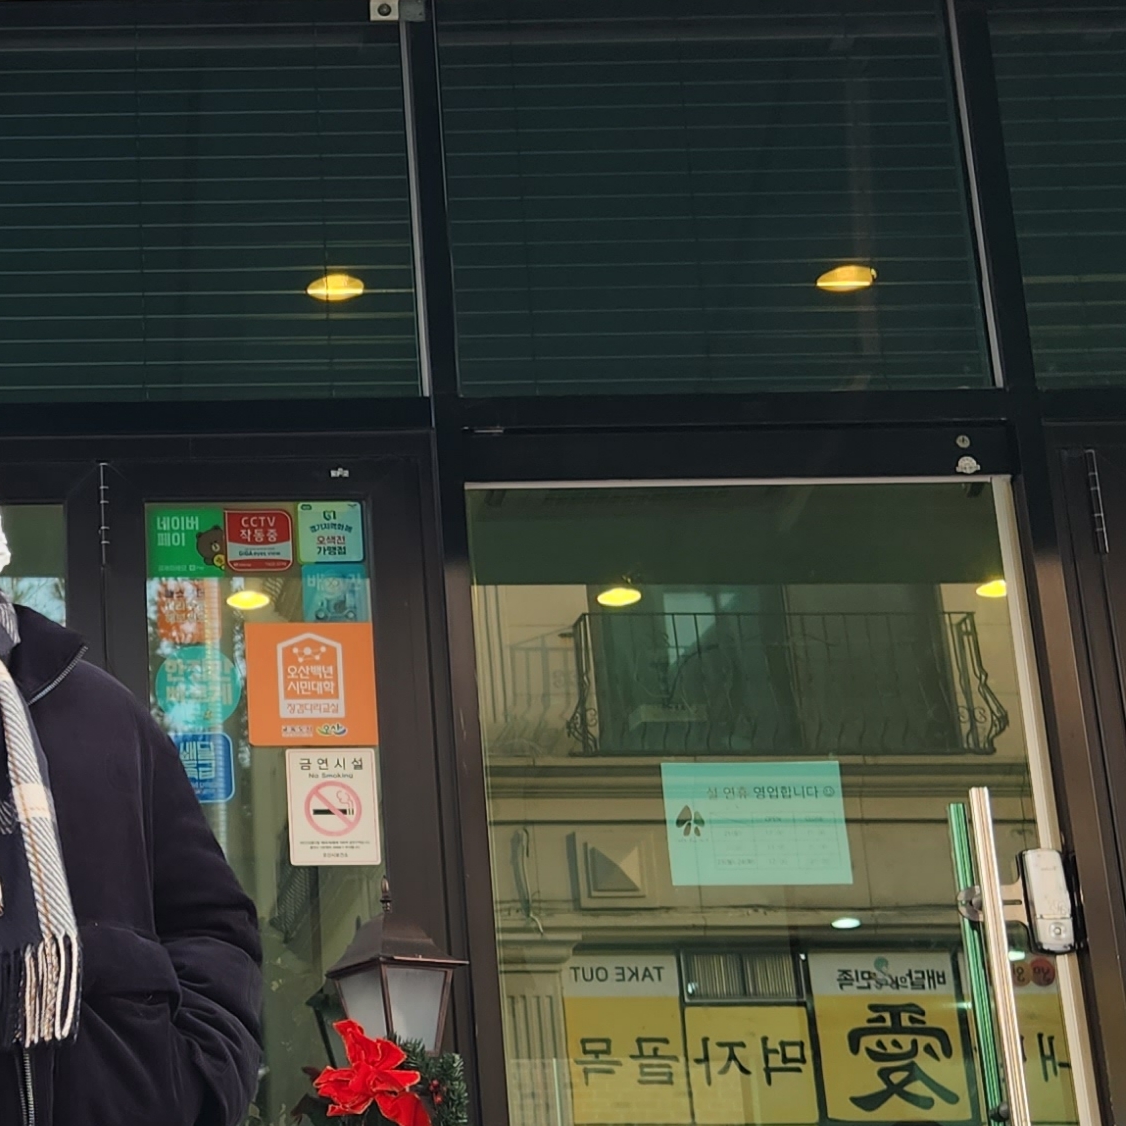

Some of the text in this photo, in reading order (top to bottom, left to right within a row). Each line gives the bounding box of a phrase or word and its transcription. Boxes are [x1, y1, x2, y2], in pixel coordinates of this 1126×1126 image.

[157, 515, 199, 531] 네이버
[241, 516, 276, 528] CCTV
[157, 532, 186, 547] 페이
[240, 528, 278, 543] 작동중
[316, 535, 346, 546] 오색전
[317, 545, 347, 556] 가맹점
[287, 665, 334, 679] 오산백년
[287, 681, 335, 695] 시민대학
[286, 702, 339, 715] 징검다리교실
[753, 785, 819, 799] 영업합니다
